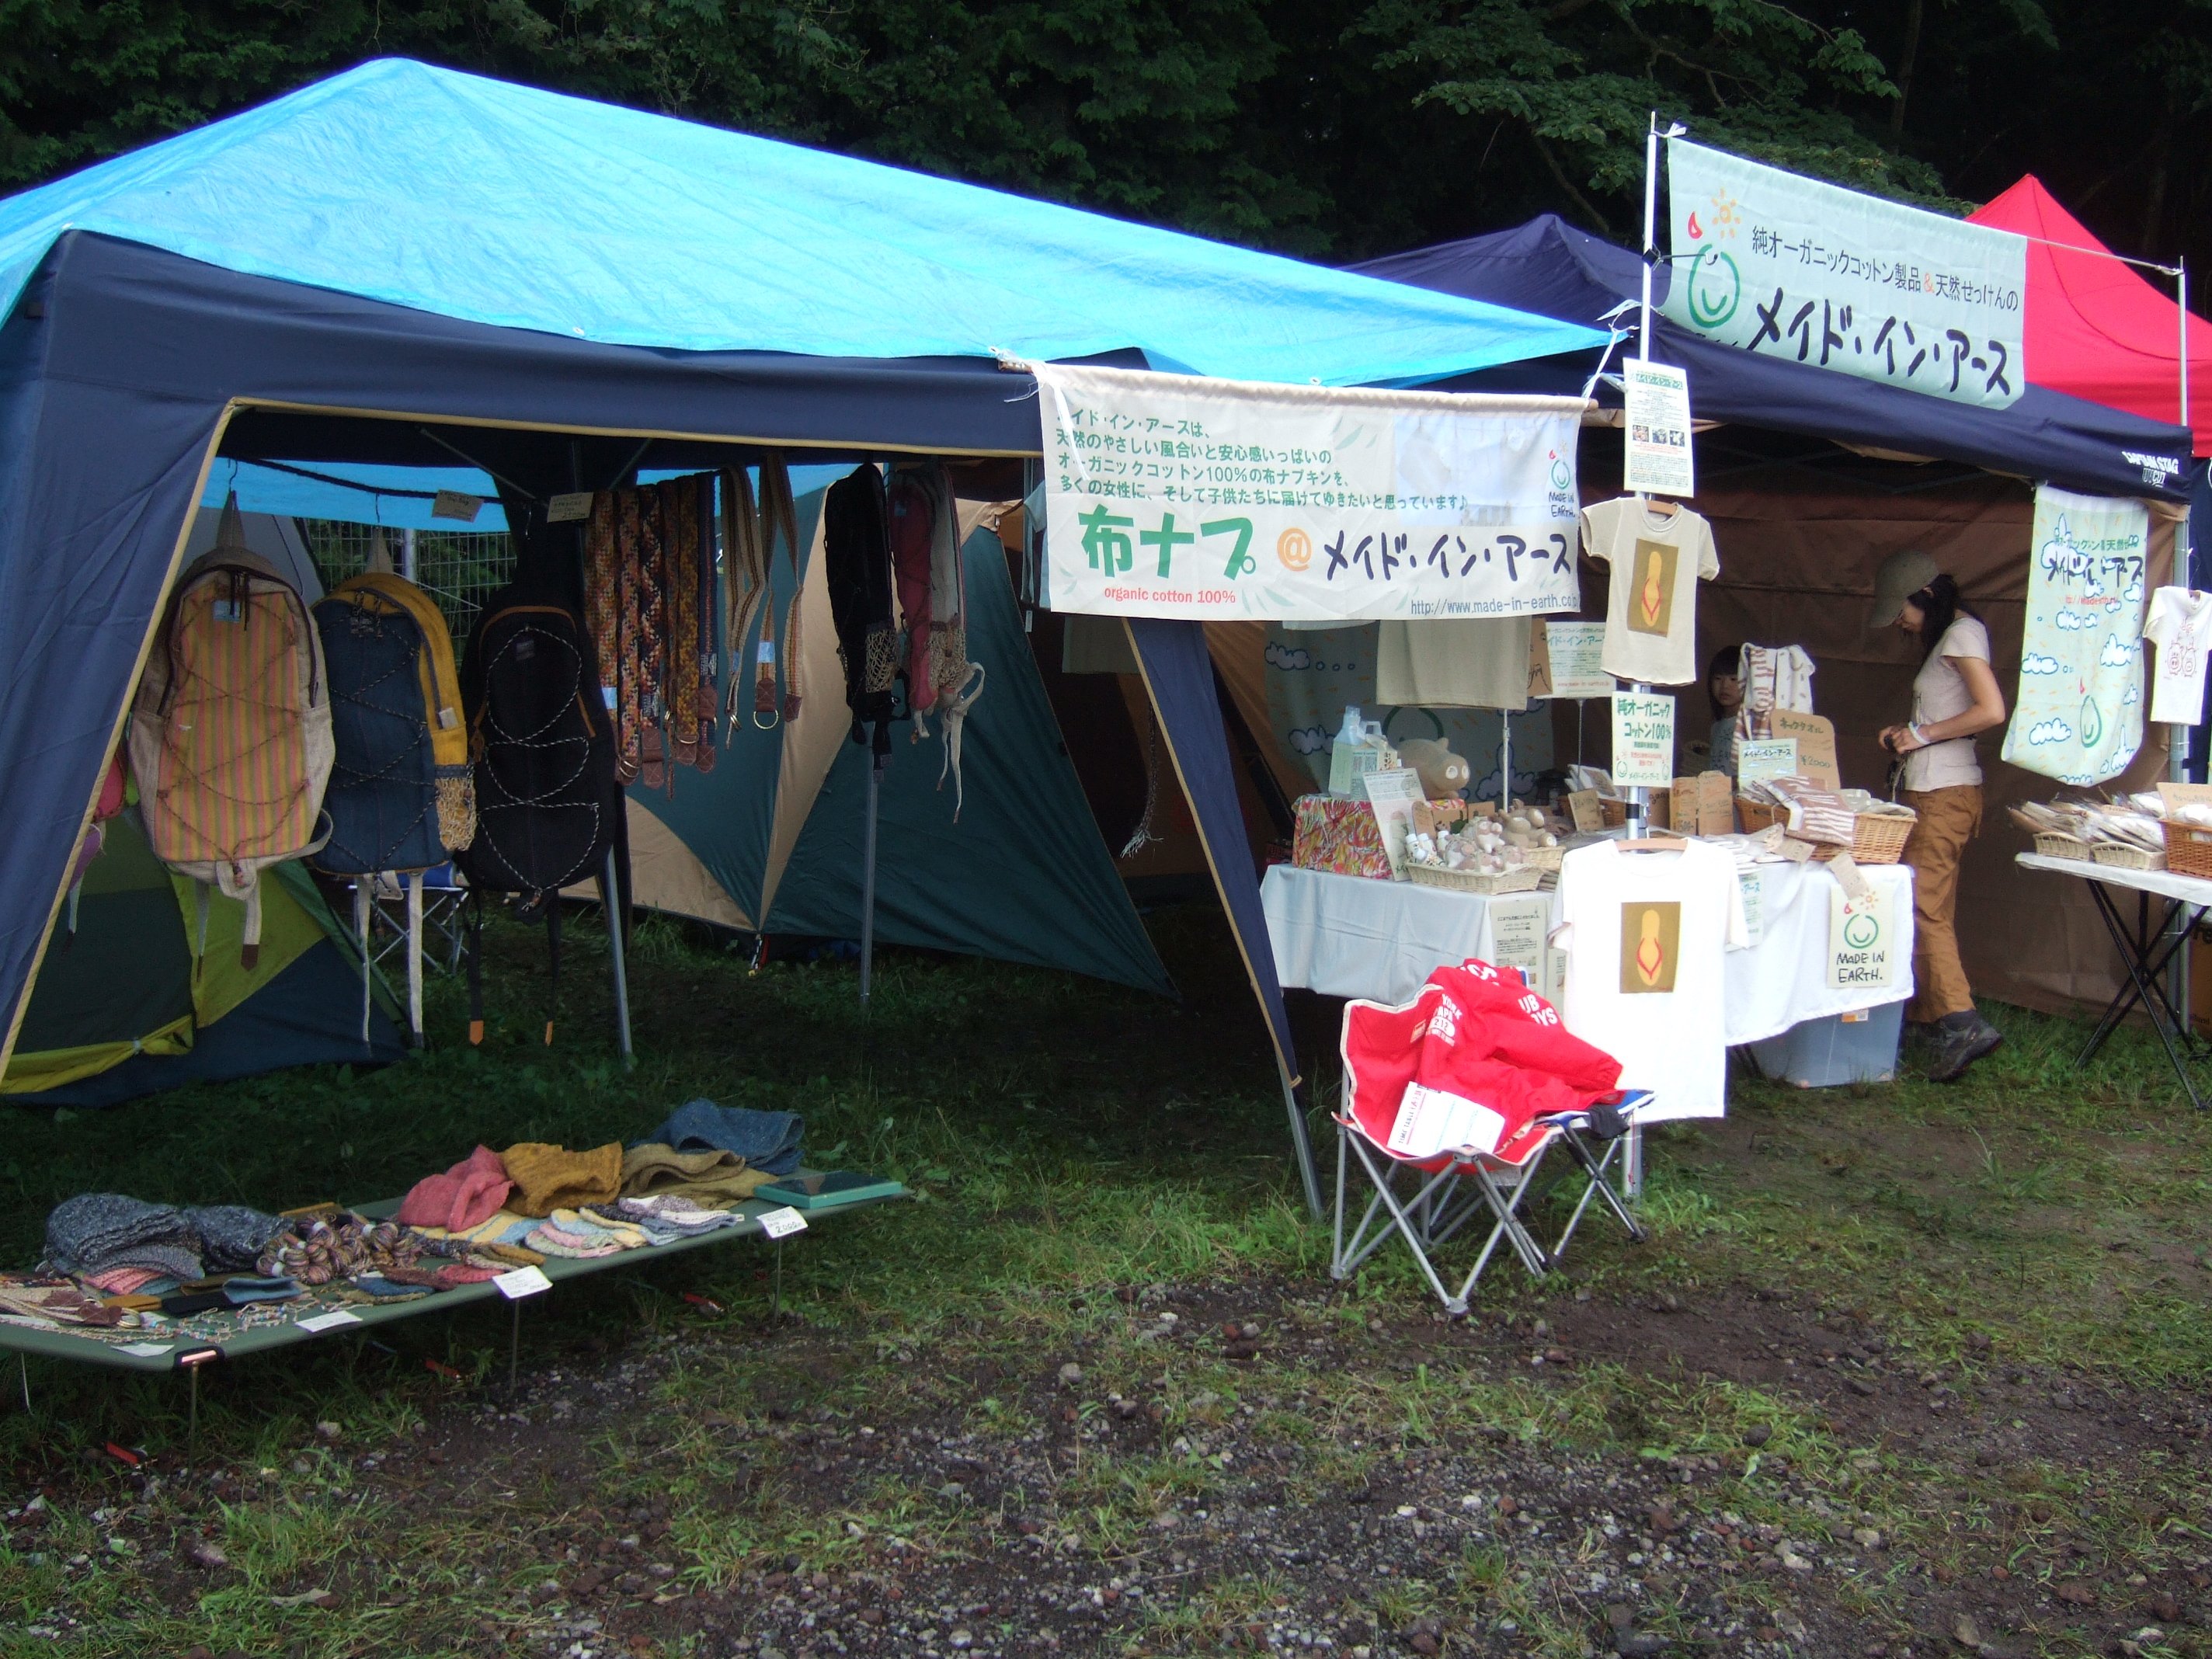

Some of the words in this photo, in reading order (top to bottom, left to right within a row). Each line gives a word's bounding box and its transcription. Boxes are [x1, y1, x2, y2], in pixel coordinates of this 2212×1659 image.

[1057, 409, 1211, 439] イド・イン・アースは、
[2156, 456, 2179, 475] STAG
[1078, 504, 1257, 581] 布ナプ
[1276, 527, 1313, 572] @
[1104, 587, 1149, 601] organic
[1152, 590, 1192, 603] cotton
[1197, 590, 1236, 604] 100%
[1873, 950, 1885, 963] IN
